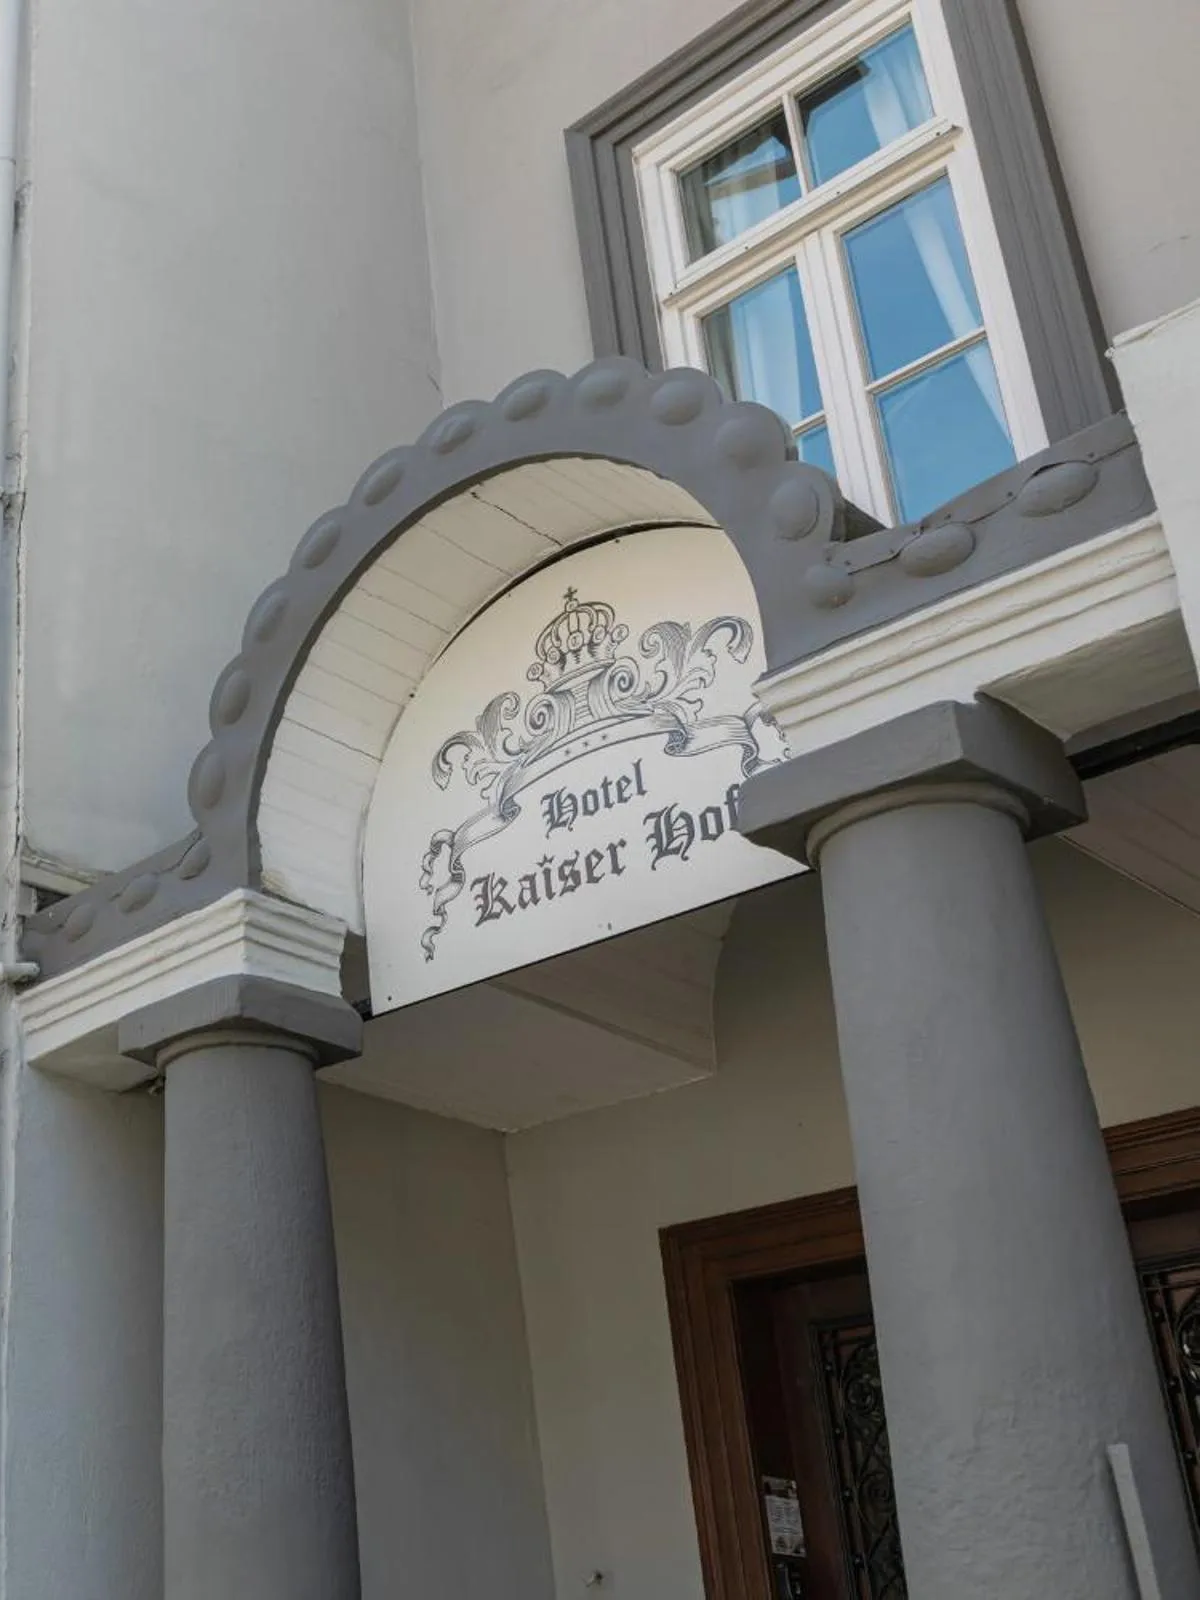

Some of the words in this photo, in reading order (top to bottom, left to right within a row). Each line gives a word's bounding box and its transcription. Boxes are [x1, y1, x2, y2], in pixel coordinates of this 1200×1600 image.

[470, 838, 627, 927] Kaiser
[642, 783, 743, 871] Hof
[540, 758, 648, 840] Hotel
